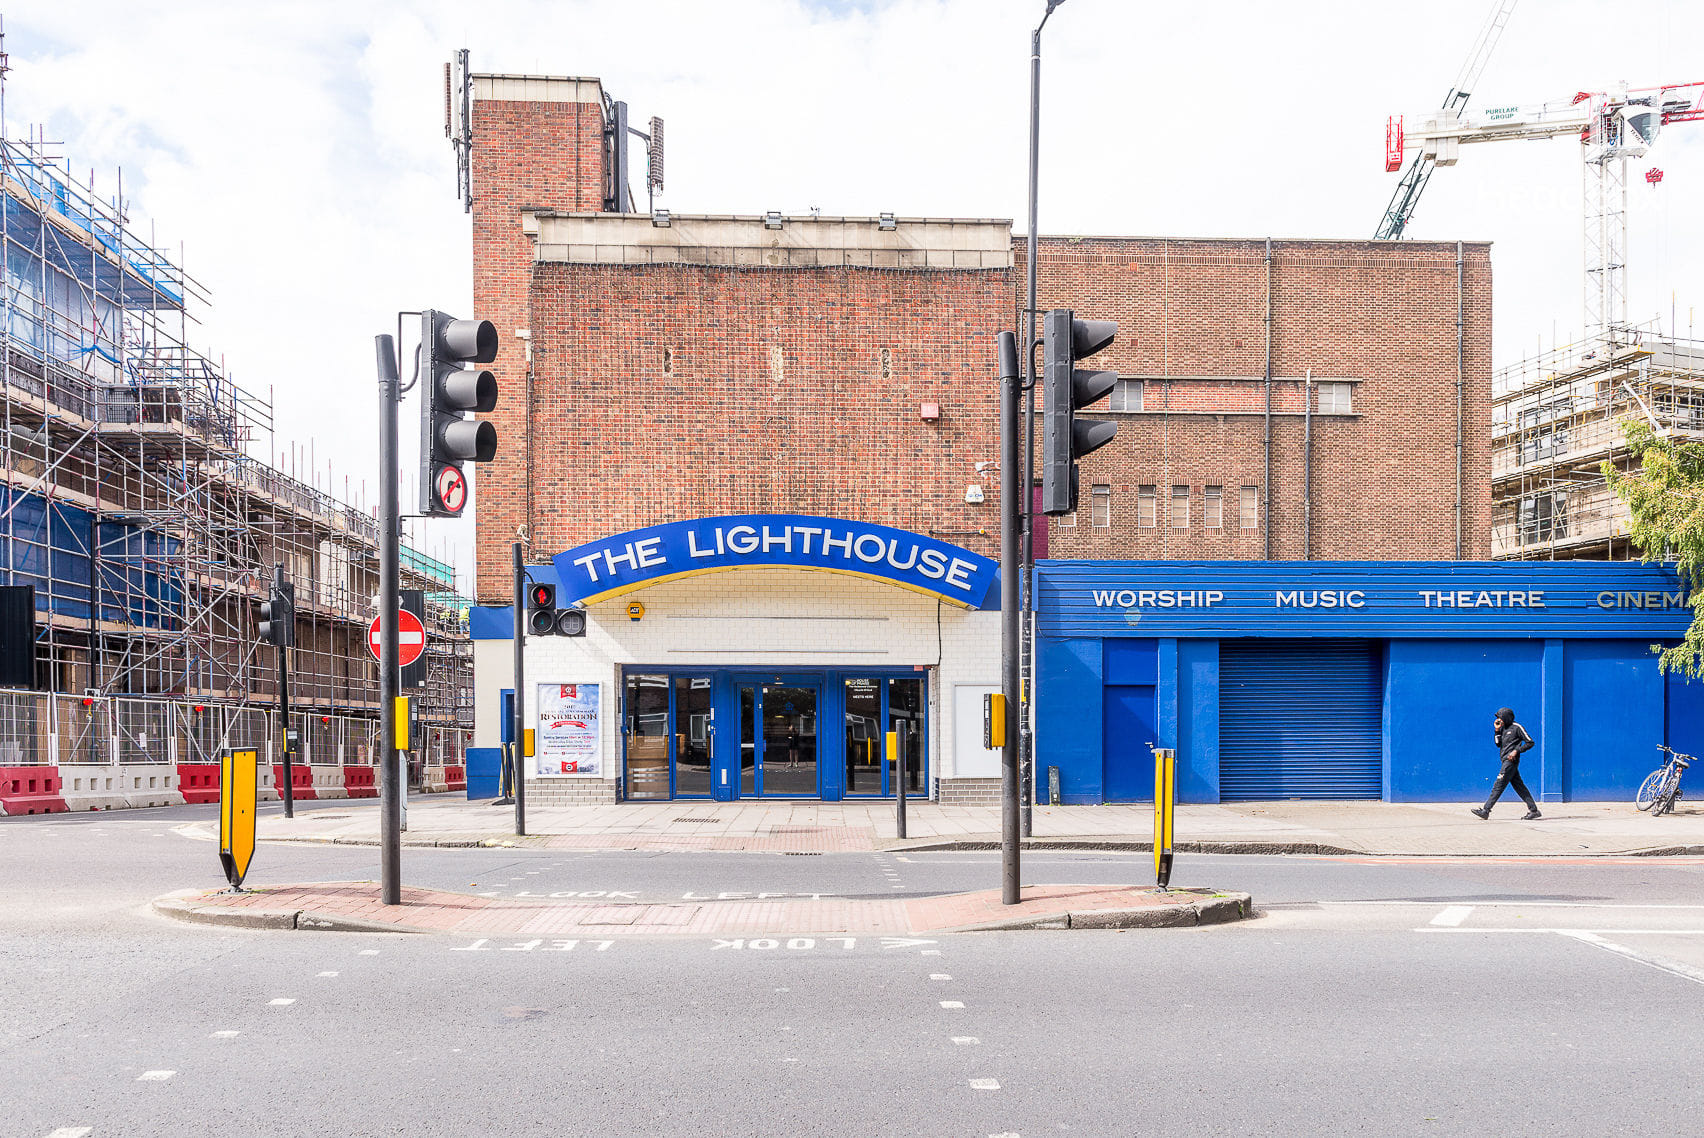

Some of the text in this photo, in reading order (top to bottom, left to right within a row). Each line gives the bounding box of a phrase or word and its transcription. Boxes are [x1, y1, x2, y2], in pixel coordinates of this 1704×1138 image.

[1485, 106, 1519, 115] PURELAKE
[573, 525, 978, 591] THE LIGHTHOUSE
[1092, 590, 1224, 607] WORSHIP
[1275, 590, 1366, 608] MUSIC
[1418, 591, 1546, 608] THEATRE
[516, 891, 835, 900] LOOK LEFT
[449, 937, 857, 951] LOOK LEFT
